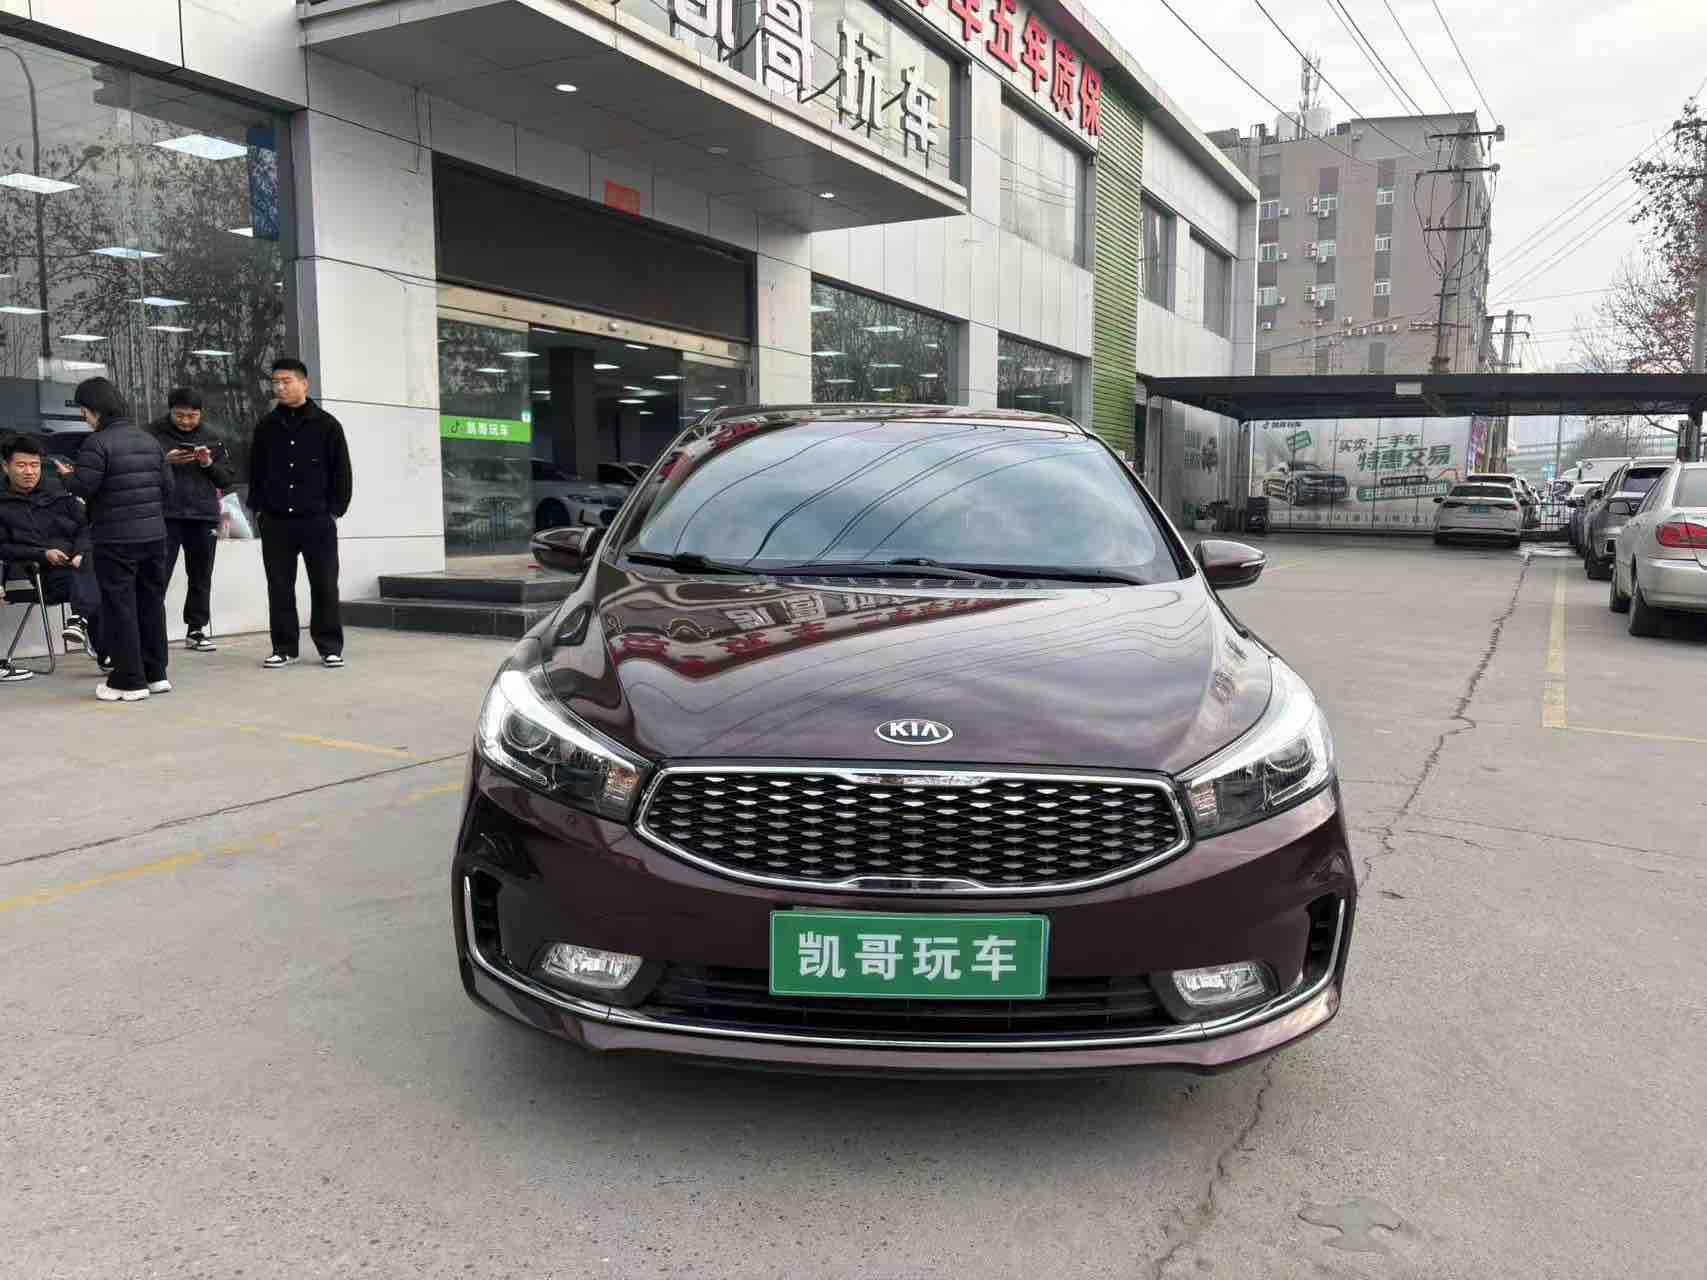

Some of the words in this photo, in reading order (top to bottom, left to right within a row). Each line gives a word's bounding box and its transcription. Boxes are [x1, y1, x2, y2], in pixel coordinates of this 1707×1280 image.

[890, 721, 941, 738] KIA
[797, 931, 1018, 982] 凯哥玩车
